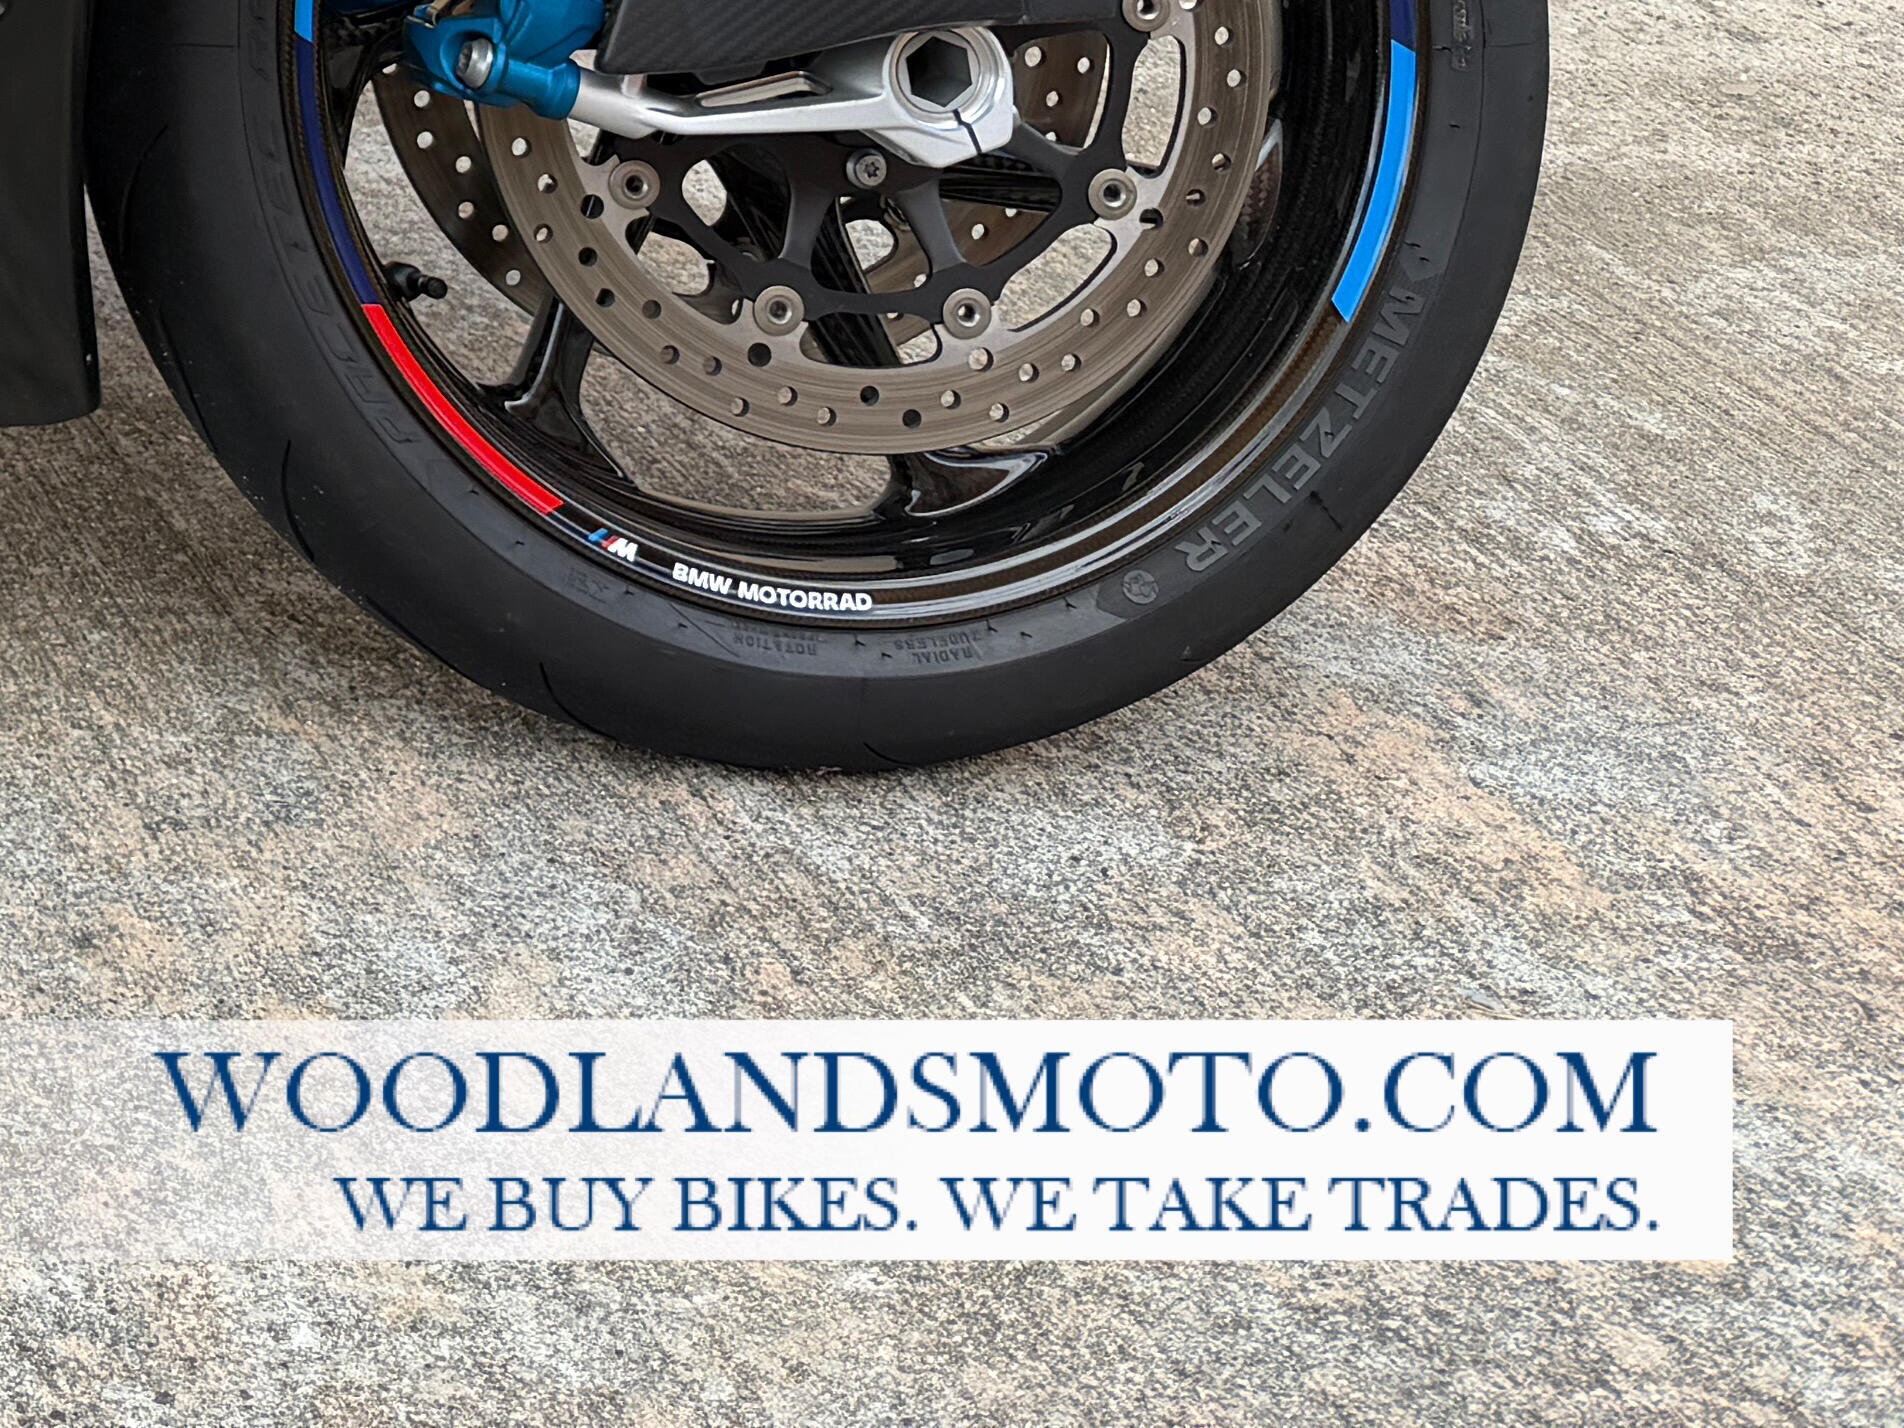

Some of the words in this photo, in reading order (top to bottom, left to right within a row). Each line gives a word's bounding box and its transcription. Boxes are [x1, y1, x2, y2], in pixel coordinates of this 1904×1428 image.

[1173, 287, 1427, 572] METZELER
[672, 561, 733, 595] BMW
[737, 580, 873, 612] MOTORRAD
